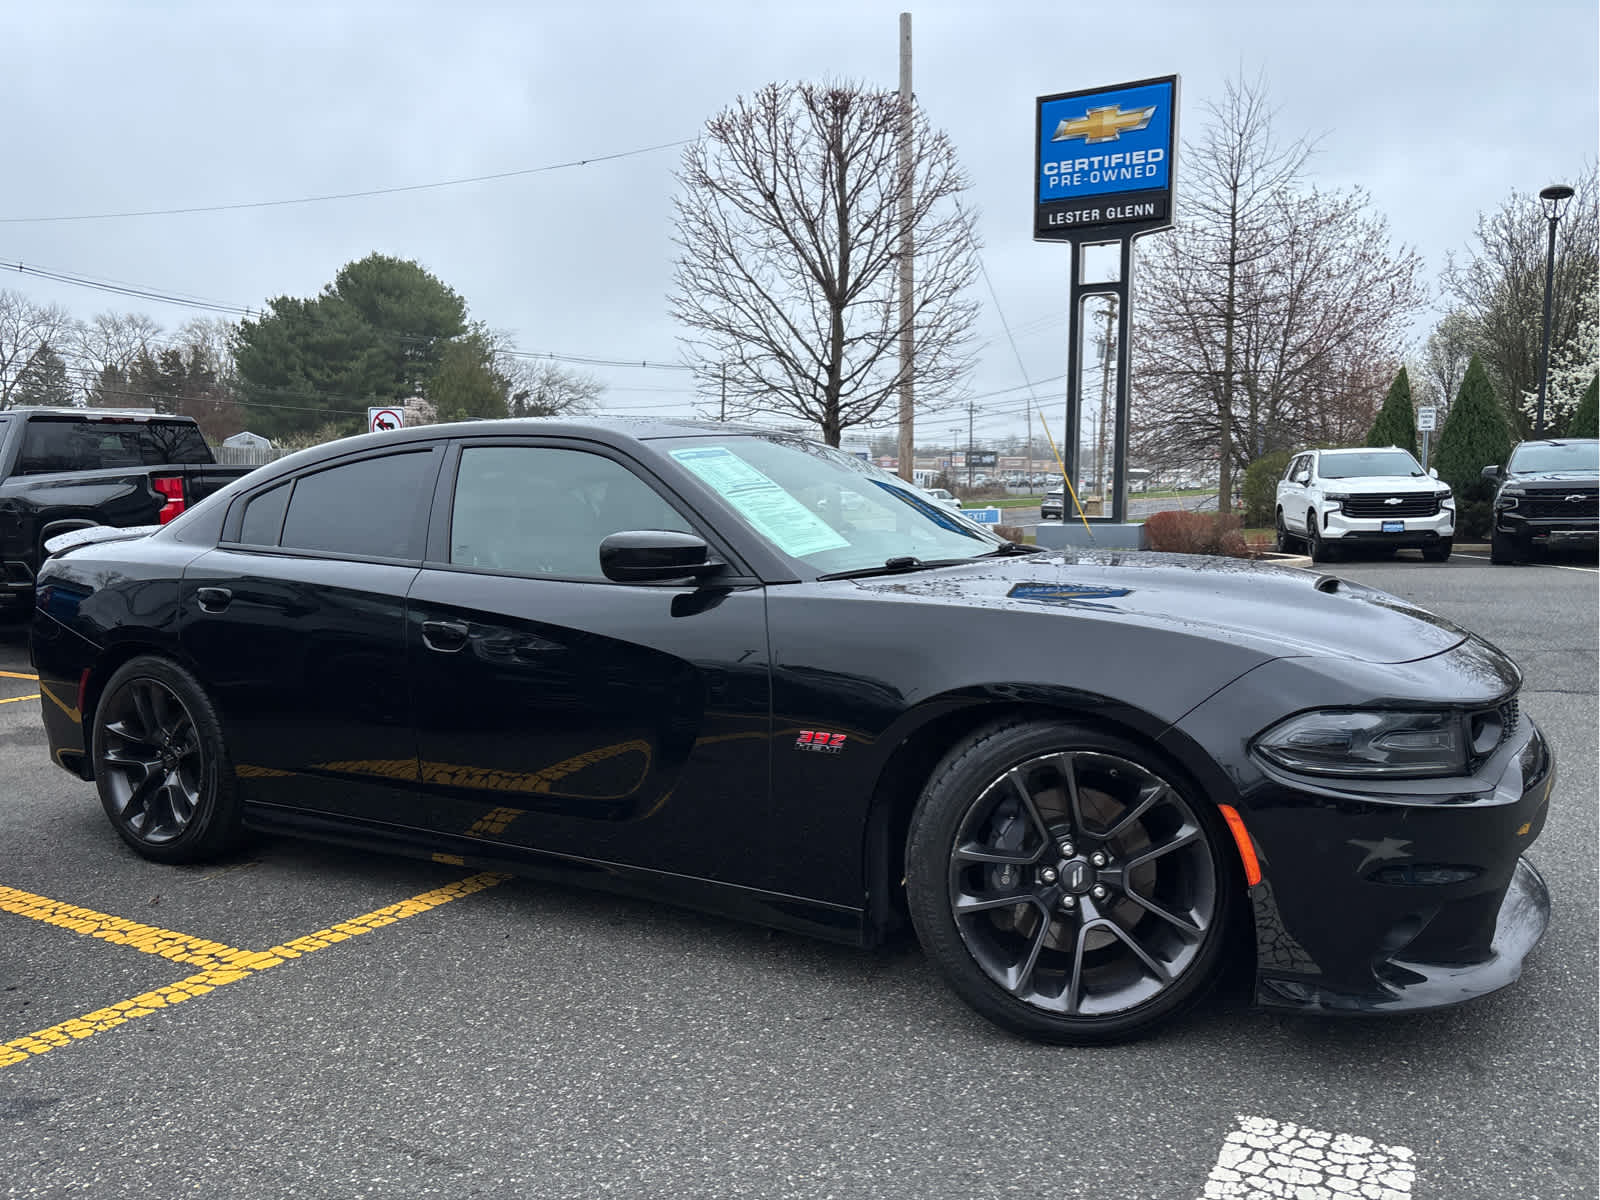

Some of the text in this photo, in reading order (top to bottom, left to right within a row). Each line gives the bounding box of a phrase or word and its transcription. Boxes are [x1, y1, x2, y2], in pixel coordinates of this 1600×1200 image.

[1044, 148, 1164, 175] CERTIFIED
[1049, 165, 1157, 188] PRE-OWNED
[1049, 203, 1154, 224] LESTER GLENN
[968, 512, 987, 521] EXIT
[797, 731, 847, 746] 392
